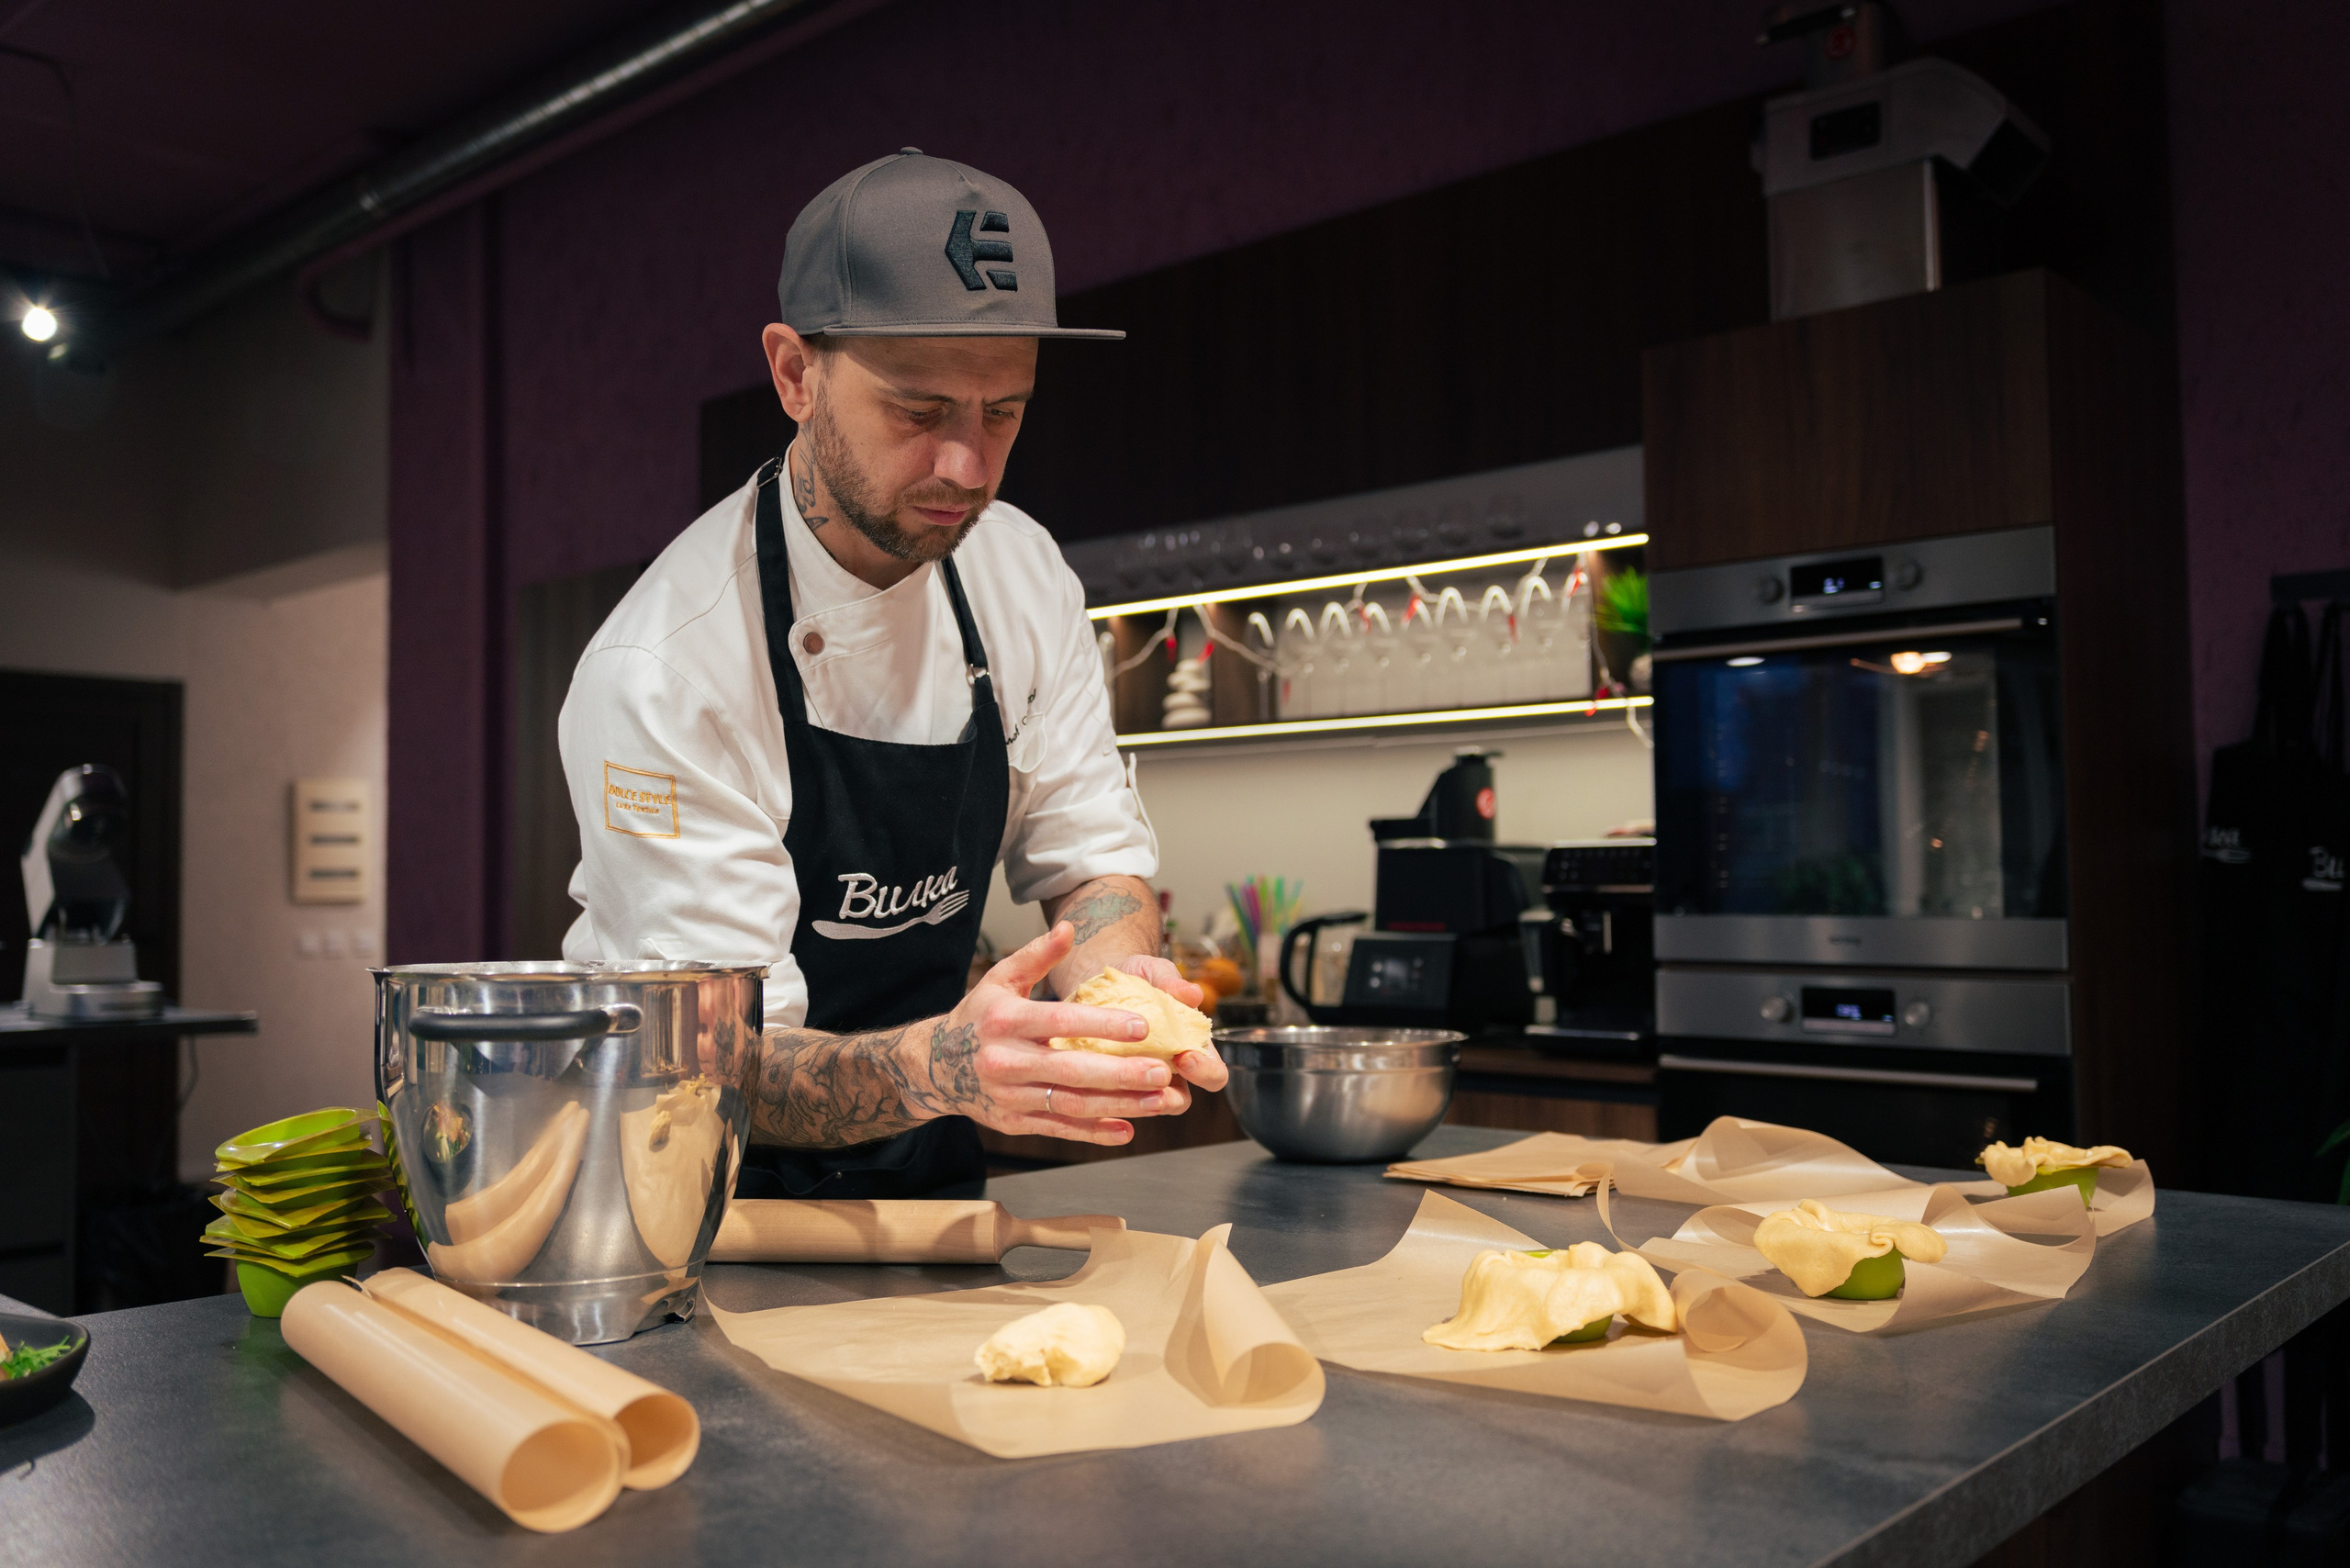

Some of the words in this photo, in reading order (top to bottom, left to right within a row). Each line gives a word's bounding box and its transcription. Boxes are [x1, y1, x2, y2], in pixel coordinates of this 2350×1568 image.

[608, 784, 637, 801] DOLCE
[639, 791, 671, 805] STYLE
[837, 866, 958, 920] Вилка
